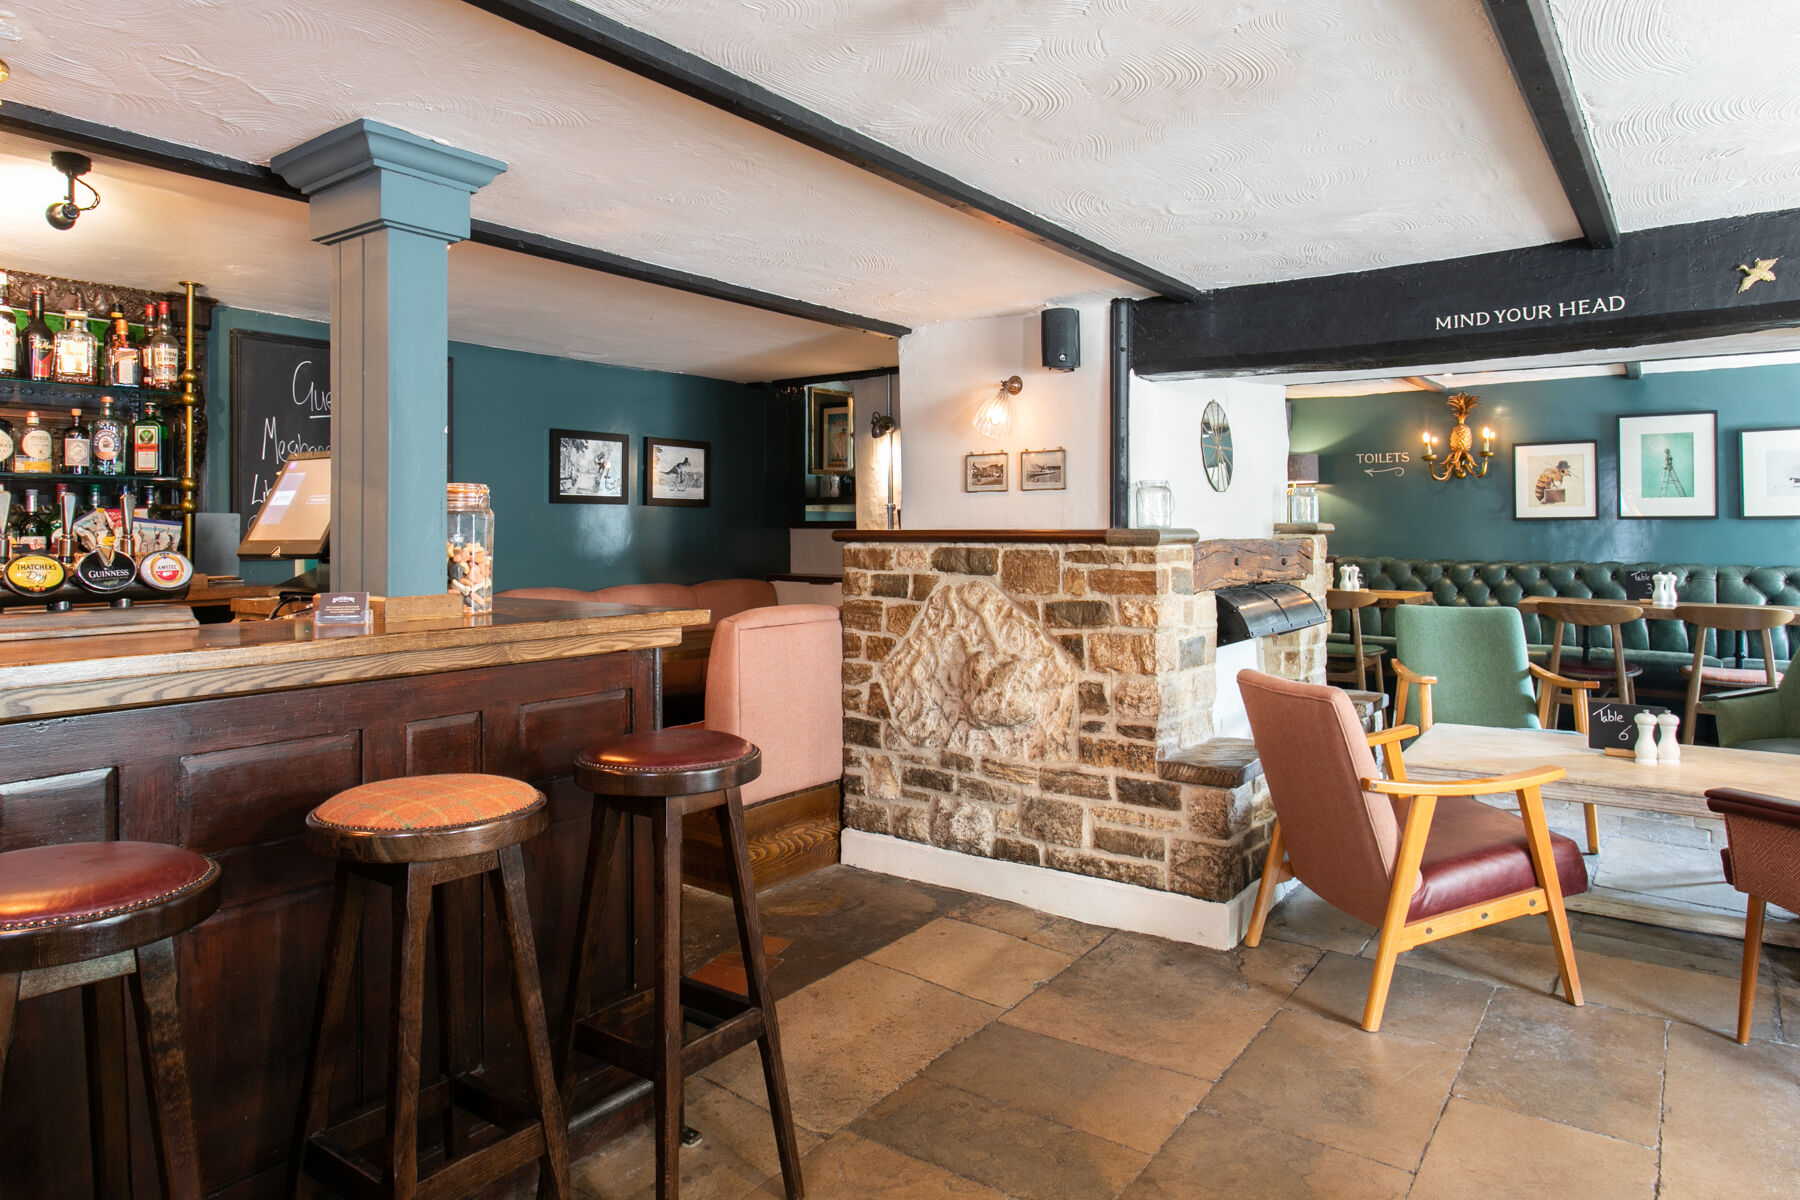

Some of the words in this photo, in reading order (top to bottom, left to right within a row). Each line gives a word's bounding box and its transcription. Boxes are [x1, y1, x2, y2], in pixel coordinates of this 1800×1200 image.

[1435, 312, 1490, 330] MIND
[1493, 305, 1552, 323] YOUR
[1558, 295, 1625, 317] HEAD
[1355, 451, 1410, 464] TOILETS
[16, 563, 57, 571] THATCHERS
[88, 569, 130, 579] GUINNESS
[26, 570, 48, 585] Dry
[1630, 570, 1650, 581] Table
[1592, 698, 1625, 723] Table
[1618, 724, 1632, 741] 6
